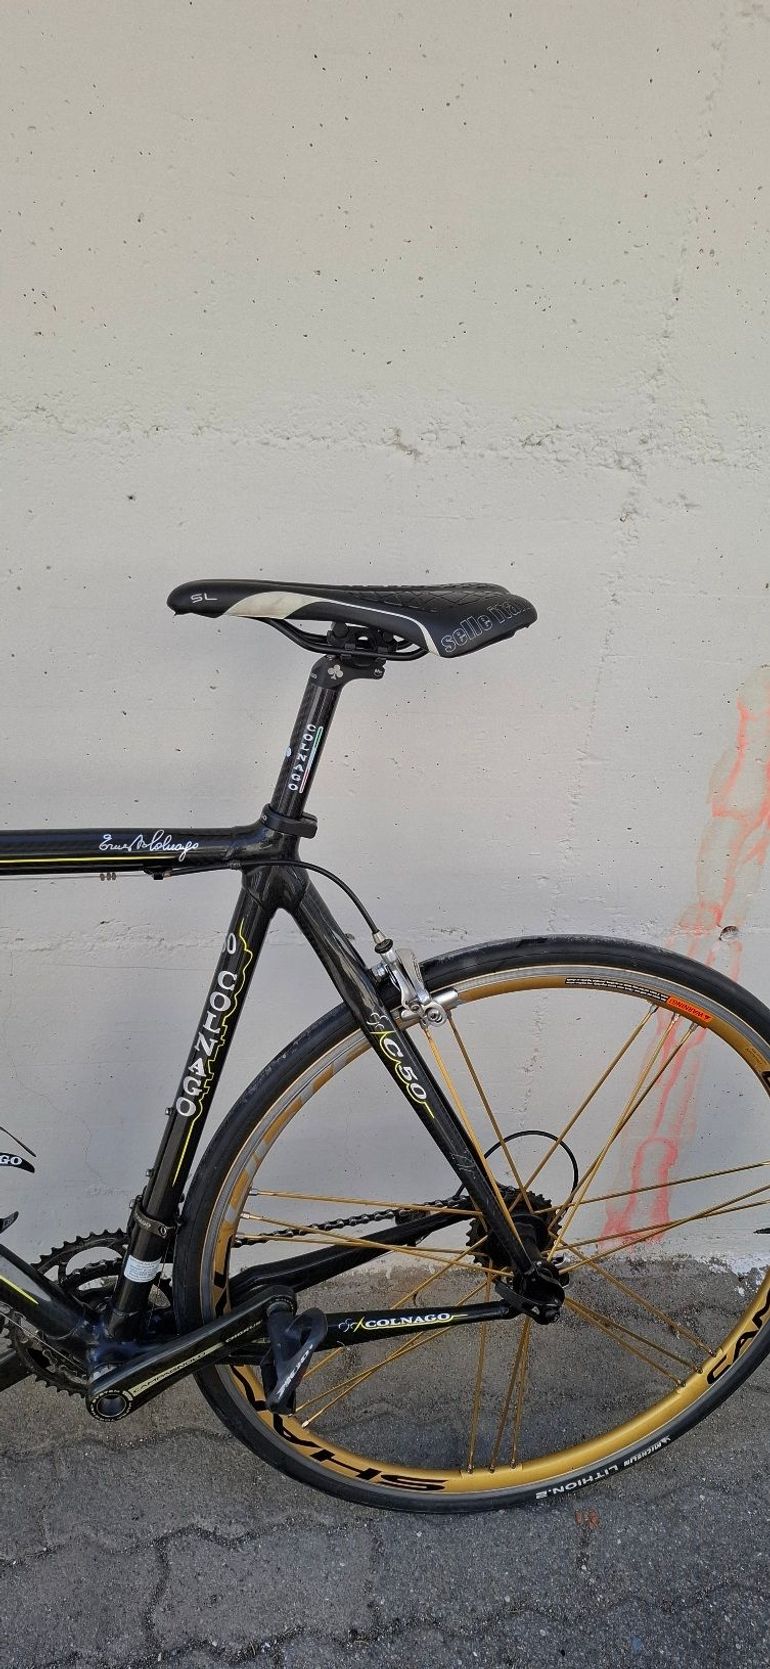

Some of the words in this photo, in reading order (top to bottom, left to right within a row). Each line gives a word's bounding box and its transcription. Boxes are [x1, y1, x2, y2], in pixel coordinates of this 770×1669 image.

[190, 592, 218, 604] SL
[441, 614, 493, 653] selle
[288, 723, 316, 791] COLNAGO
[175, 970, 238, 1117] COLNAGO
[365, 1312, 450, 1328] COLNAGO
[623, 1441, 662, 1467] MICHELIN
